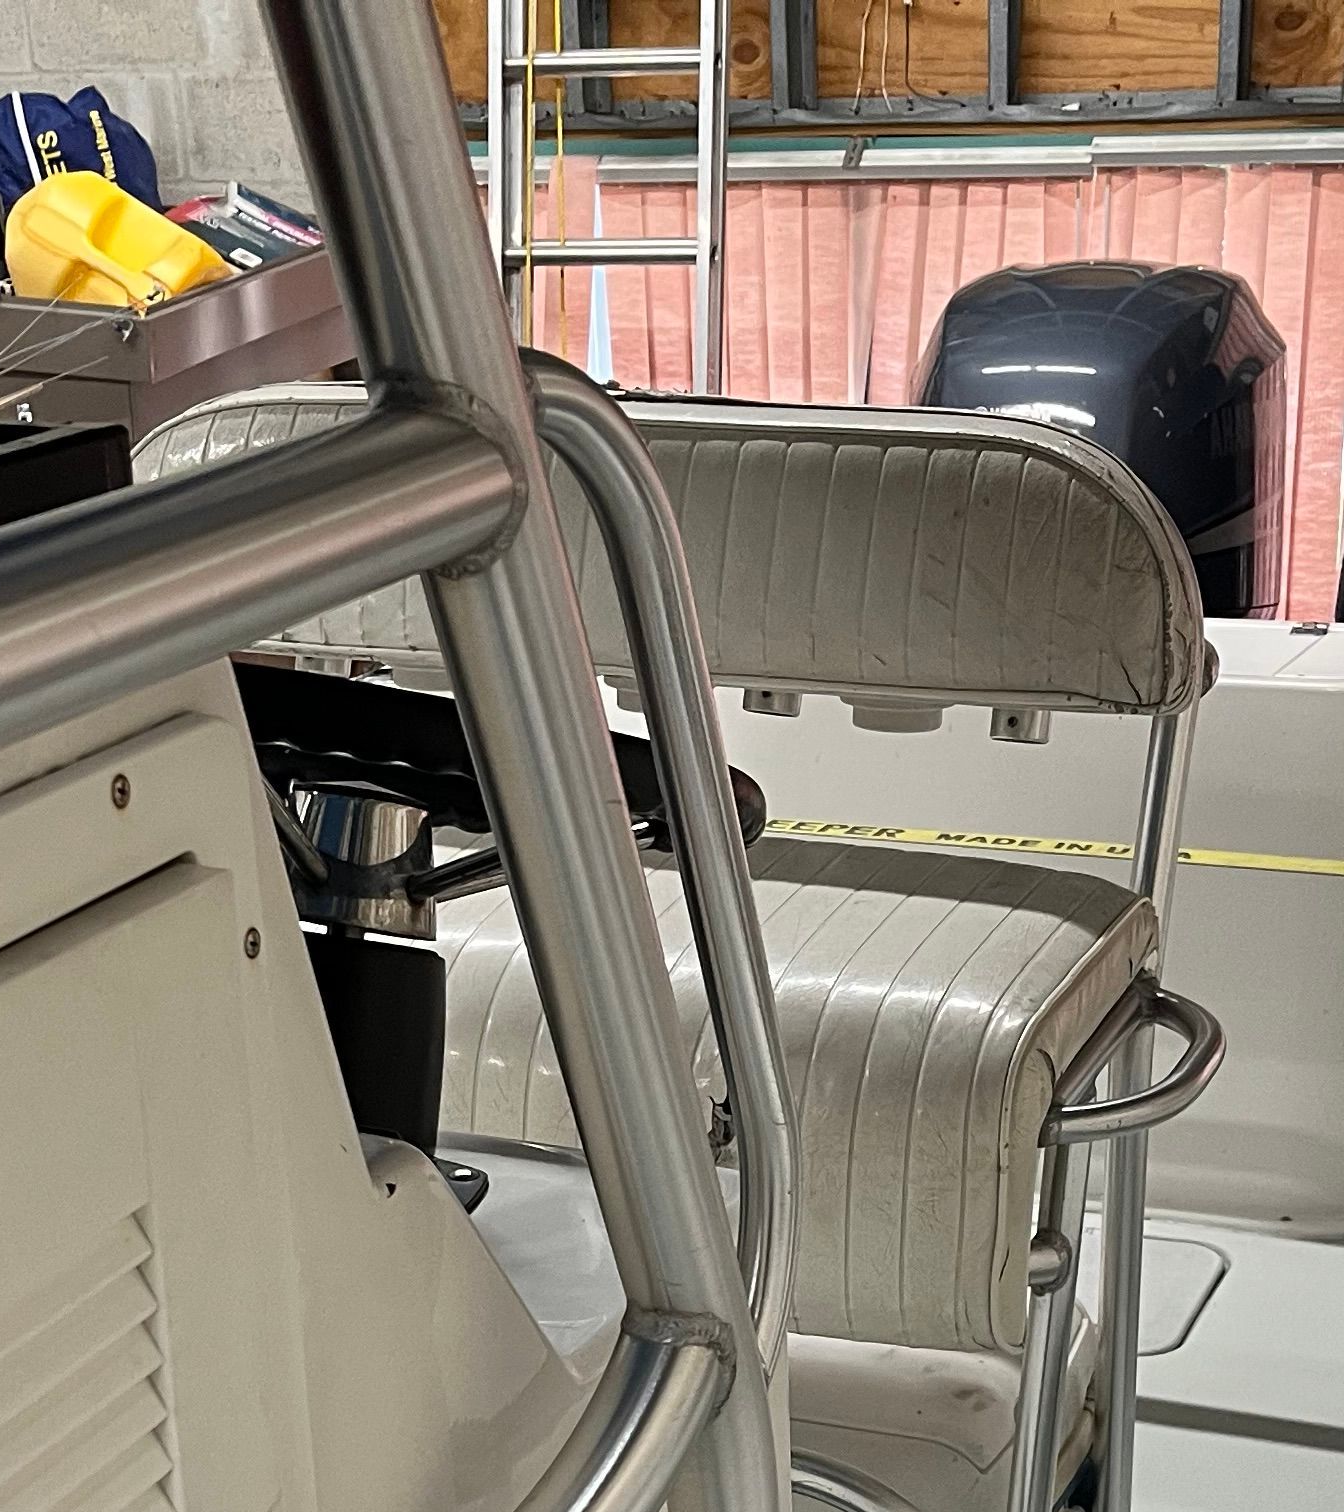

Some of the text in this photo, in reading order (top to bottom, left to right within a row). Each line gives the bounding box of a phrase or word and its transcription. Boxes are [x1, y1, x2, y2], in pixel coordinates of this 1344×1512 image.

[37, 130, 67, 177] ETS
[765, 819, 906, 839] EEPER
[934, 832, 1044, 849] MADE
[1054, 842, 1093, 852] IN
